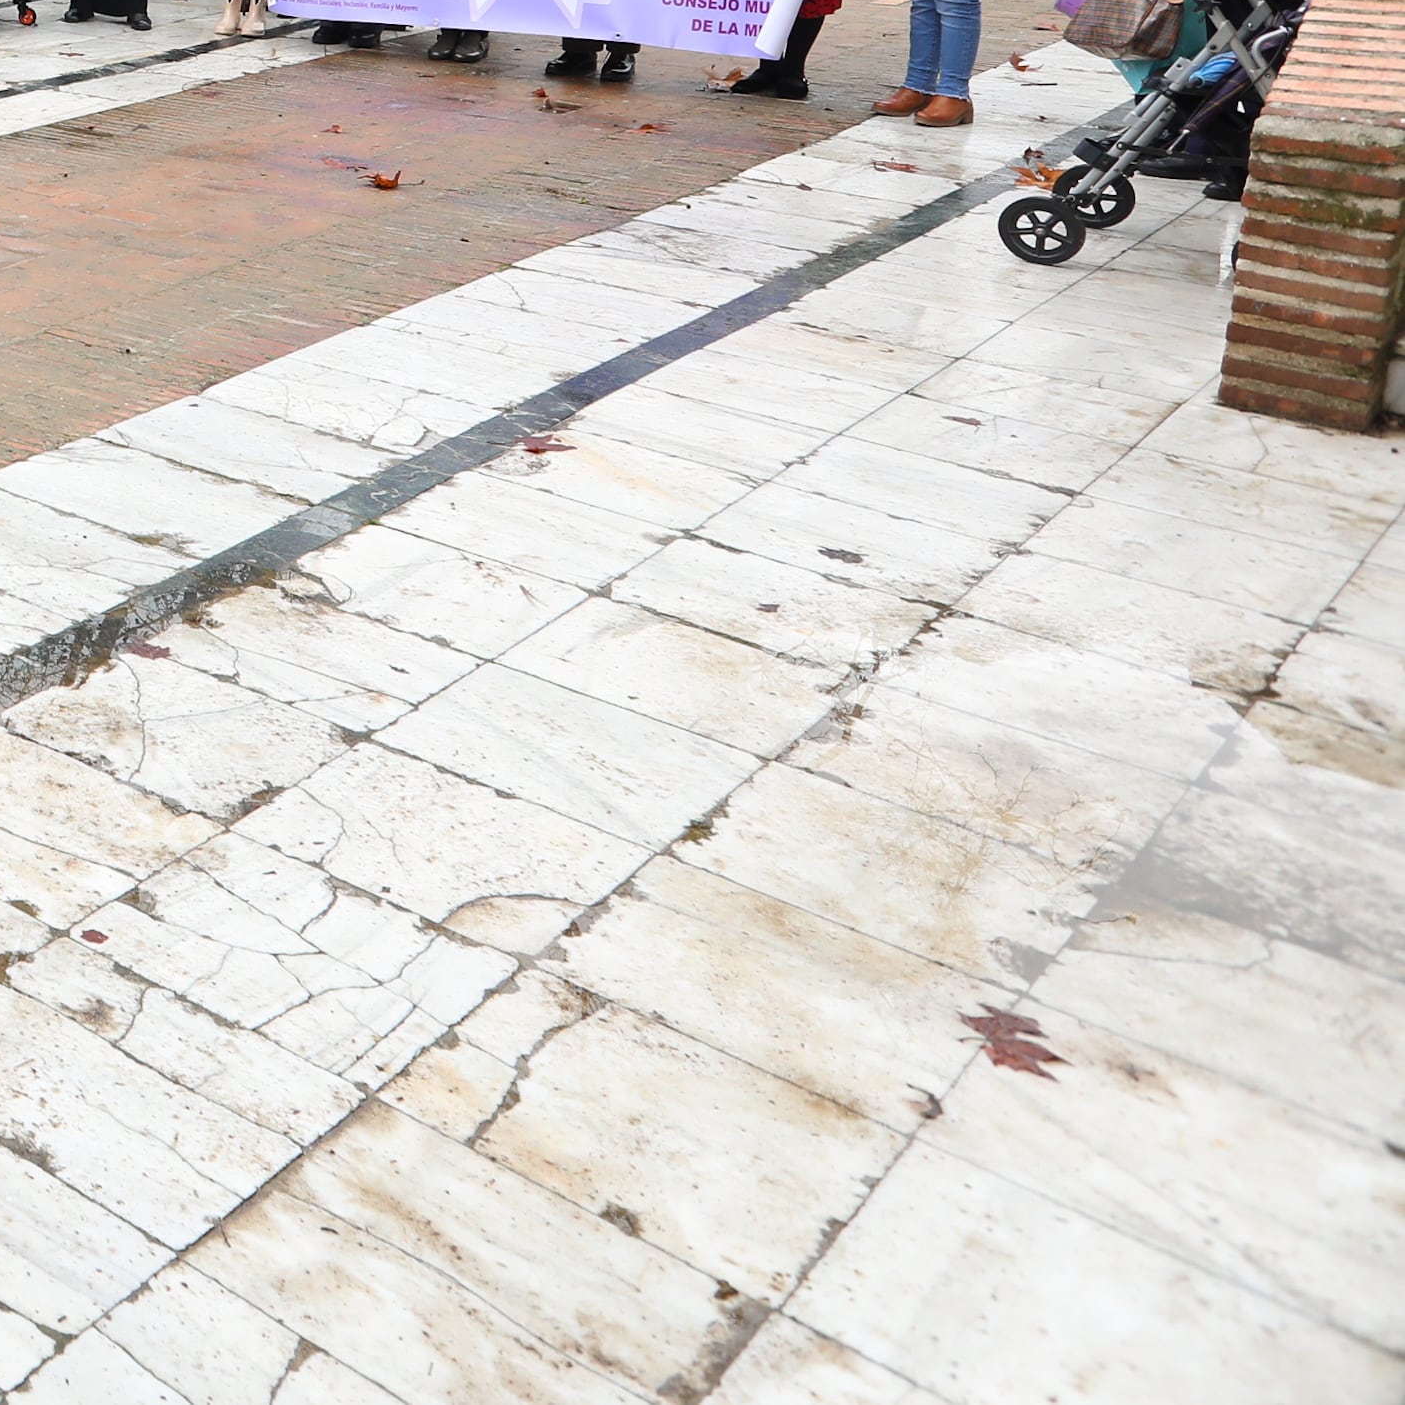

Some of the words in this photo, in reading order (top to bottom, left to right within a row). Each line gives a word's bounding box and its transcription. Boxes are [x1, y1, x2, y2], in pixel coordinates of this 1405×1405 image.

[745, 0, 771, 14] MU
[691, 18, 713, 33] DE
[718, 21, 739, 35] LA
